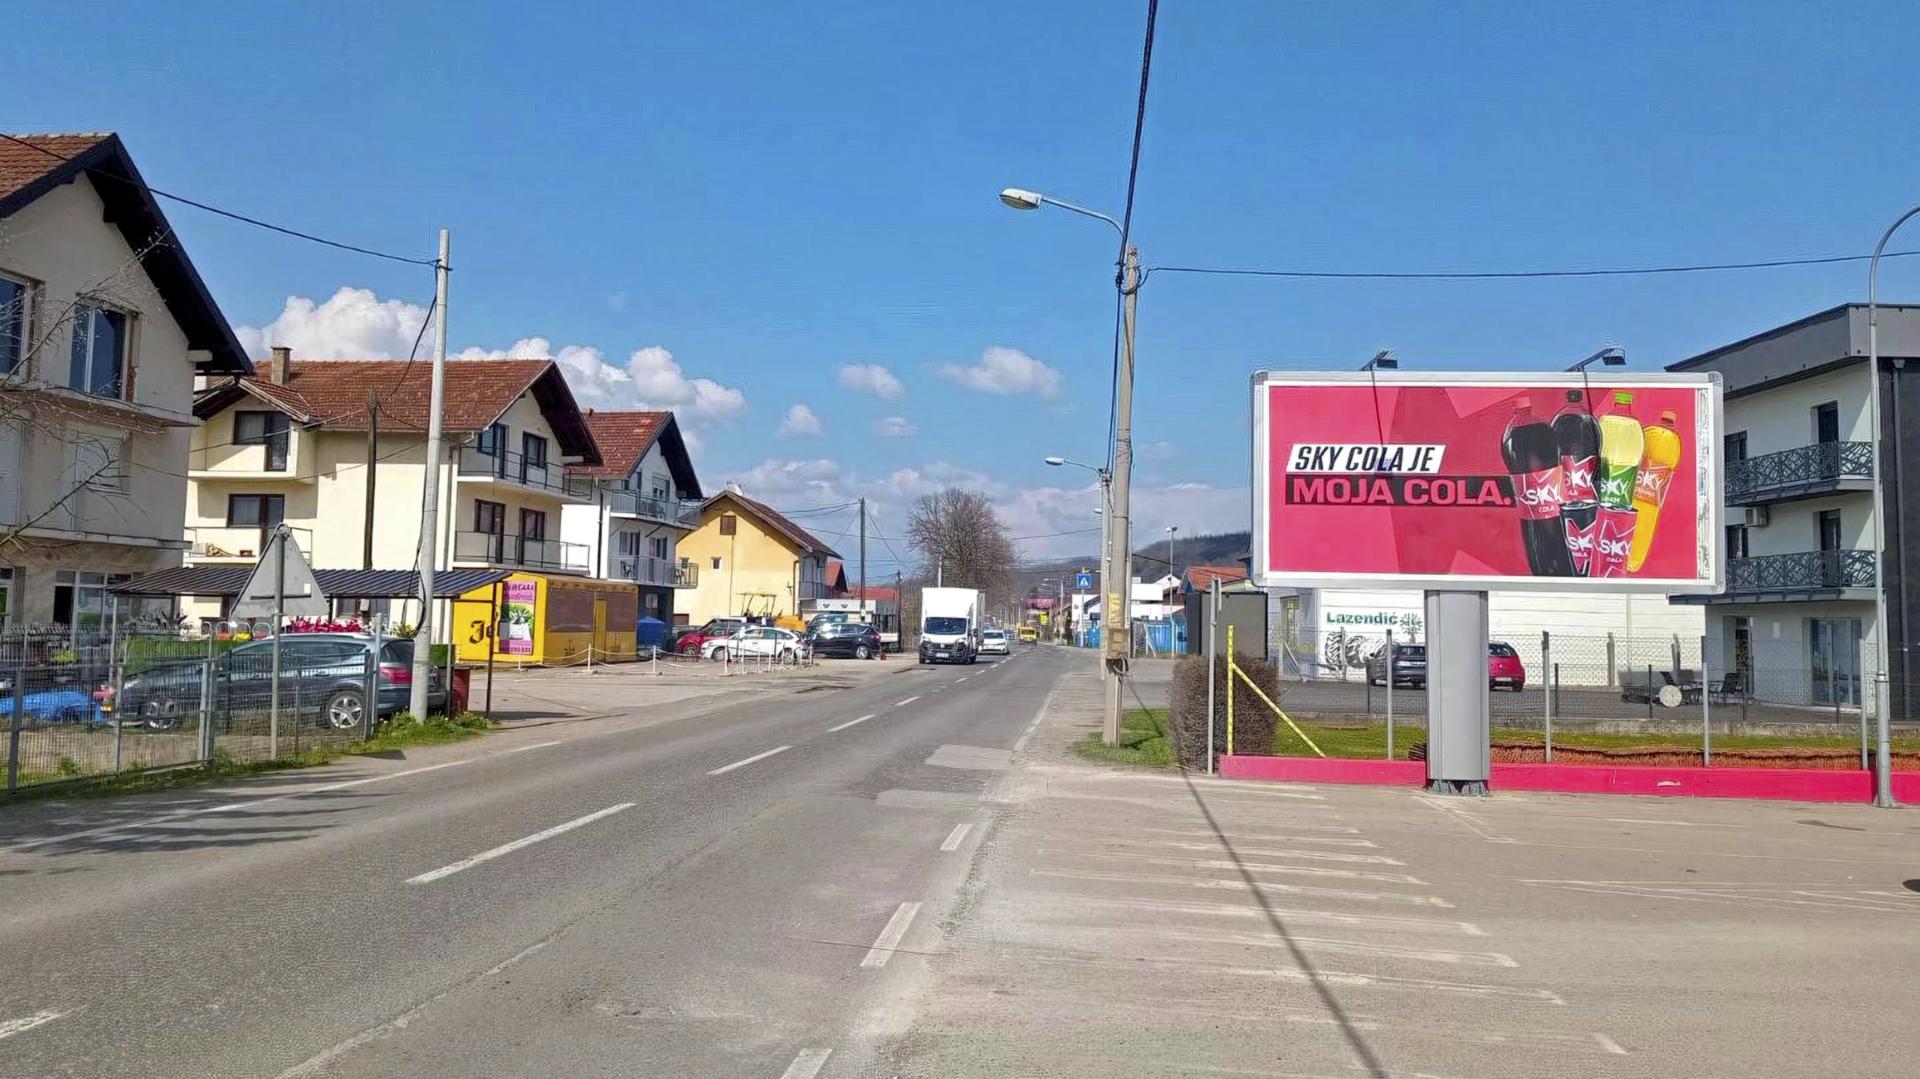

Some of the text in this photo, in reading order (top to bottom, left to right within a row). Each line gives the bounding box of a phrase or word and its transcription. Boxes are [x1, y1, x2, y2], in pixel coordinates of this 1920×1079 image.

[1295, 446, 1436, 472] SKY COLA JE
[1293, 478, 1512, 505] MOJA COLA.
[1526, 484, 1562, 505] SKY
[1600, 478, 1630, 496] SKY
[1599, 538, 1632, 556] SKY
[1326, 612, 1398, 625] Lazendić
